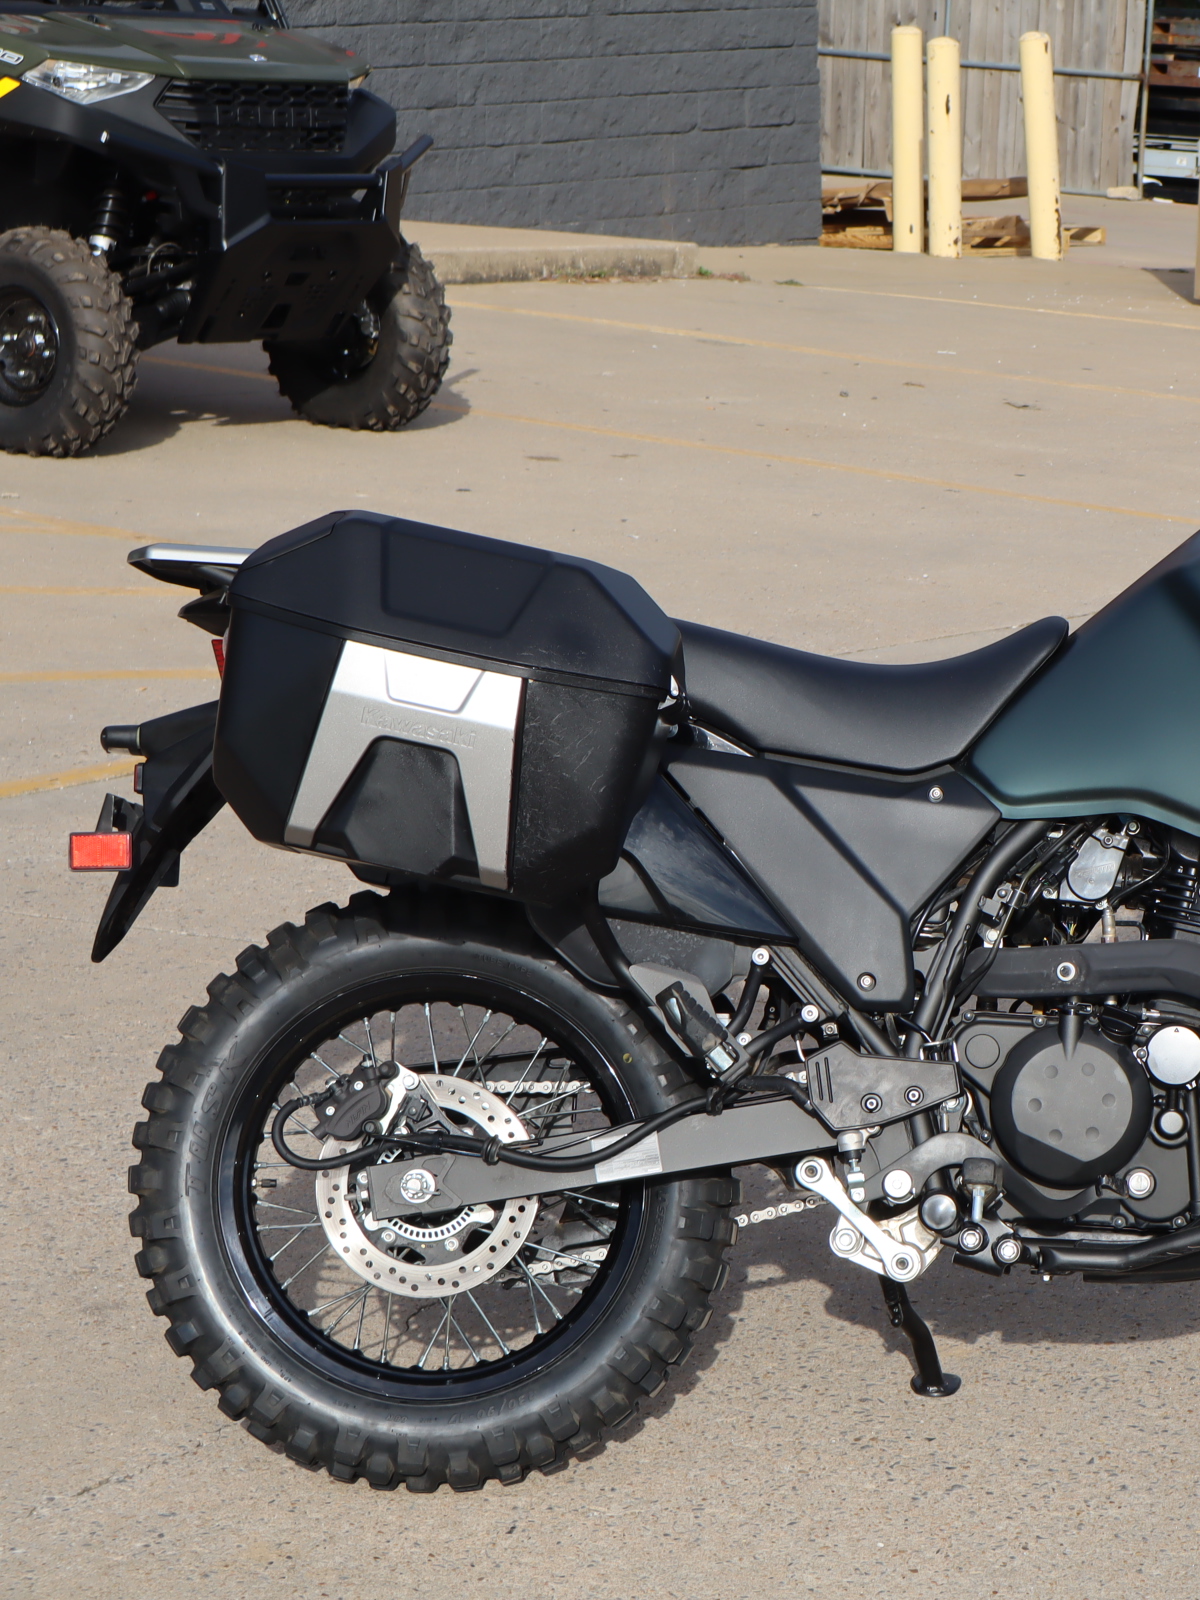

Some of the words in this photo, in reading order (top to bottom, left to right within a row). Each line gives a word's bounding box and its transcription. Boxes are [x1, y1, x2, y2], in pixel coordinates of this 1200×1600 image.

[0, 47, 24, 65] 0
[216, 105, 346, 128] POLARIS
[359, 706, 477, 749] Kawasaki
[185, 1041, 247, 1197] TUSK
